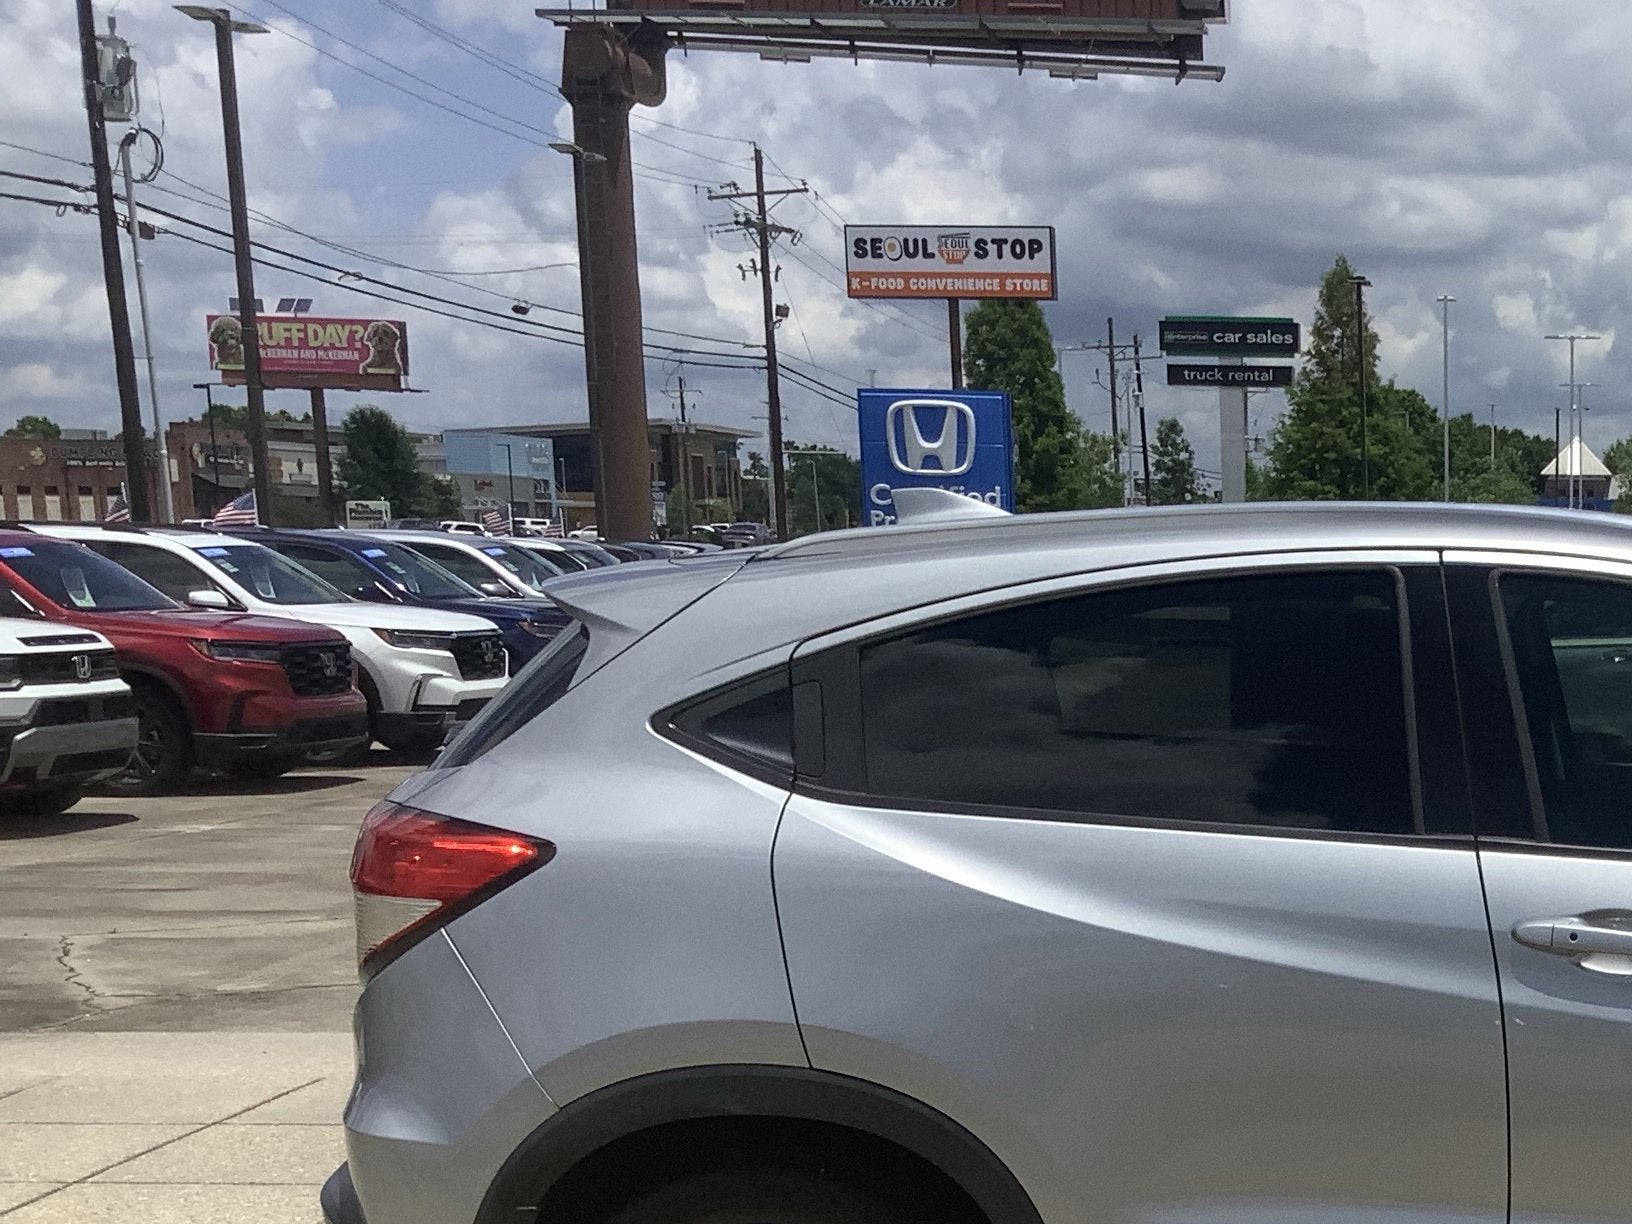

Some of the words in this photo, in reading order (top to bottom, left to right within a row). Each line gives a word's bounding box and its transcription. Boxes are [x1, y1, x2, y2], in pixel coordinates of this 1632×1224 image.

[853, 236, 936, 262] SEOUL
[974, 238, 1044, 260] STOP
[851, 277, 904, 290] K-FOOD
[909, 278, 1001, 291] CONVENIENCE
[1005, 279, 1049, 292] STORE
[307, 323, 364, 348] DAY?
[1212, 332, 1243, 343] car
[1246, 329, 1294, 344] sales
[300, 350, 317, 359] AND
[1184, 368, 1223, 380] truck
[1228, 369, 1274, 381] rental
